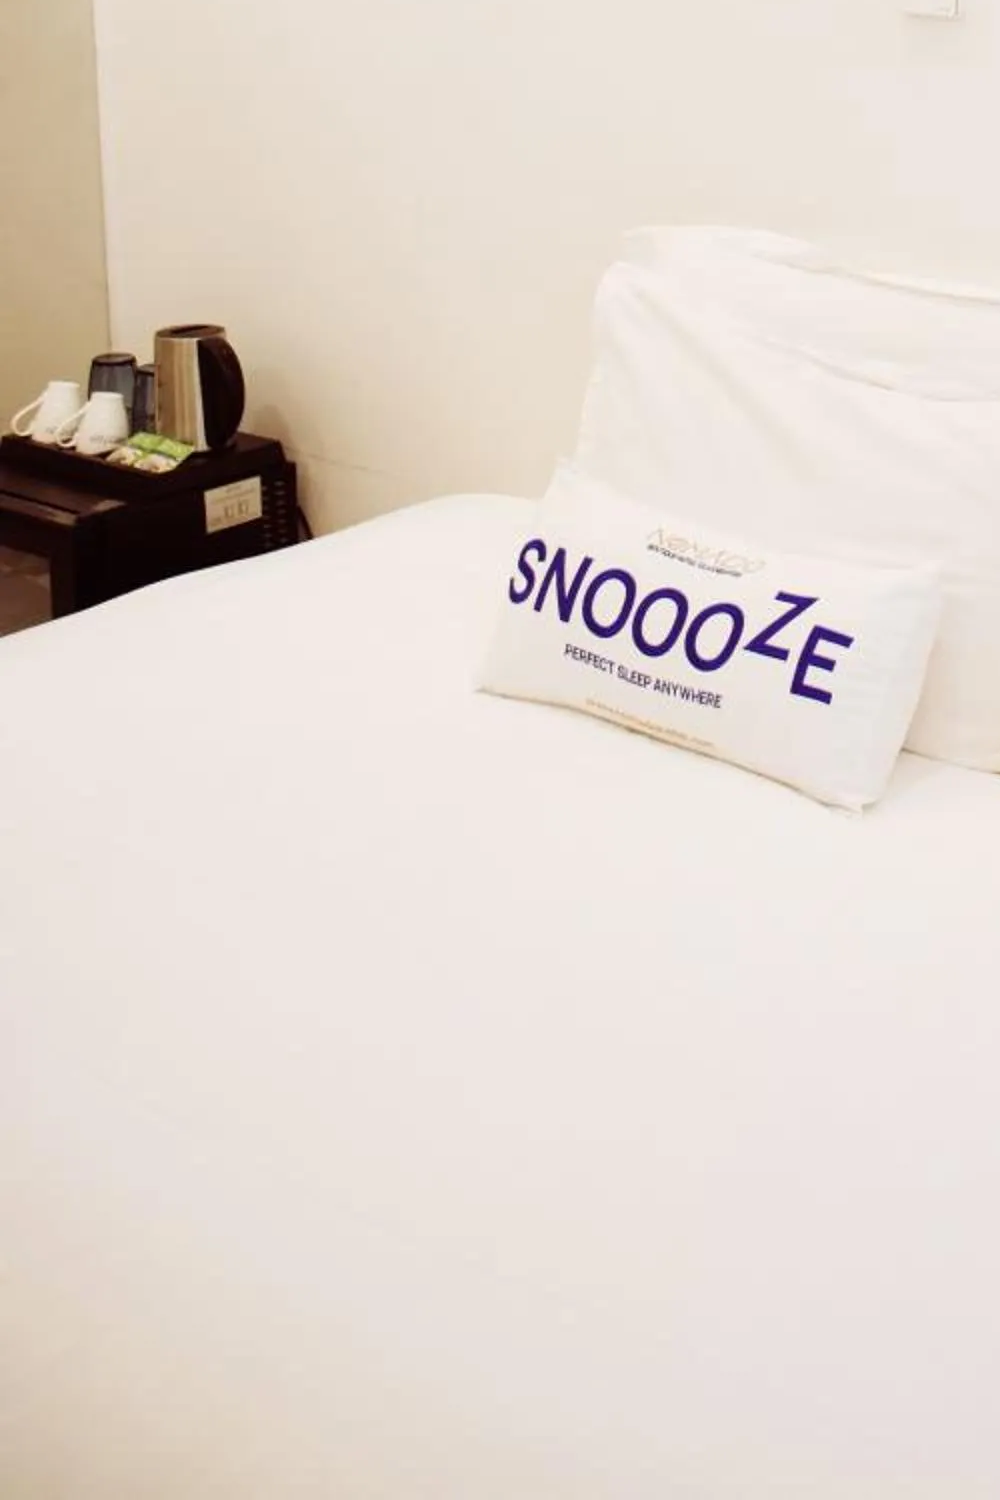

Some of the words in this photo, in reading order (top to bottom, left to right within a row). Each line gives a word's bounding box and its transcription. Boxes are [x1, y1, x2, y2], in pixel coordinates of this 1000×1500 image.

[508, 537, 855, 706] SNOOOZE
[563, 643, 616, 674] PERFECT
[617, 665, 652, 688] SLEEP
[653, 678, 723, 709] ANYWHERE
